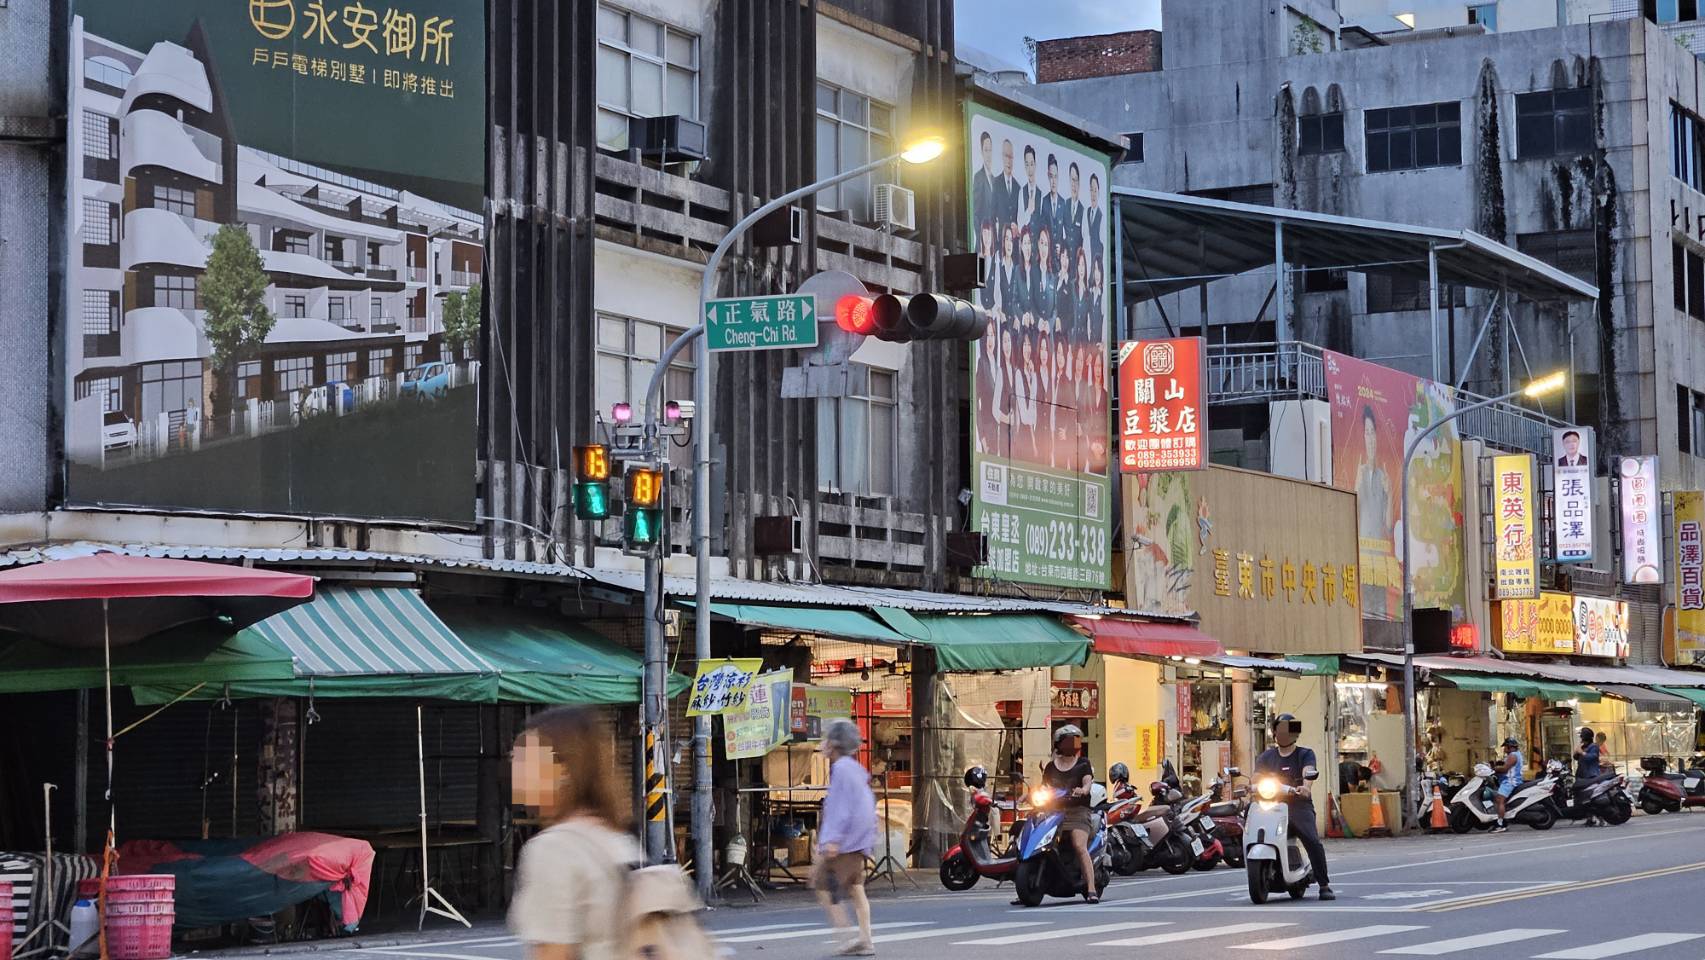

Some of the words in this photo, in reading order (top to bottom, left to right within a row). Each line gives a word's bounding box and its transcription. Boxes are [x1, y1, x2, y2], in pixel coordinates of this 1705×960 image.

[302, 0, 454, 66] 永安御所
[253, 48, 366, 85] 戶戶電梯別墅
[384, 68, 454, 98] 即將推出
[724, 299, 796, 324] 正氣路
[725, 326, 779, 347] Cheng-Chi
[782, 325, 798, 342] Rd.
[1134, 377, 1185, 405] 關山
[1124, 405, 1196, 435] 豆漿店
[1124, 437, 1196, 451] 歡迎團體訂購
[1138, 449, 1196, 460] 089-353933
[981, 509, 1020, 545] 台東皇丞
[1502, 472, 1524, 546] 東英行
[1561, 479, 1585, 539] 張品澤
[1025, 519, 1106, 566] (089)233-338
[1212, 547, 1357, 608] 臺東市中央市場
[1679, 524, 1702, 607] 品澤百貨
[696, 671, 753, 691] 台灣涼衫
